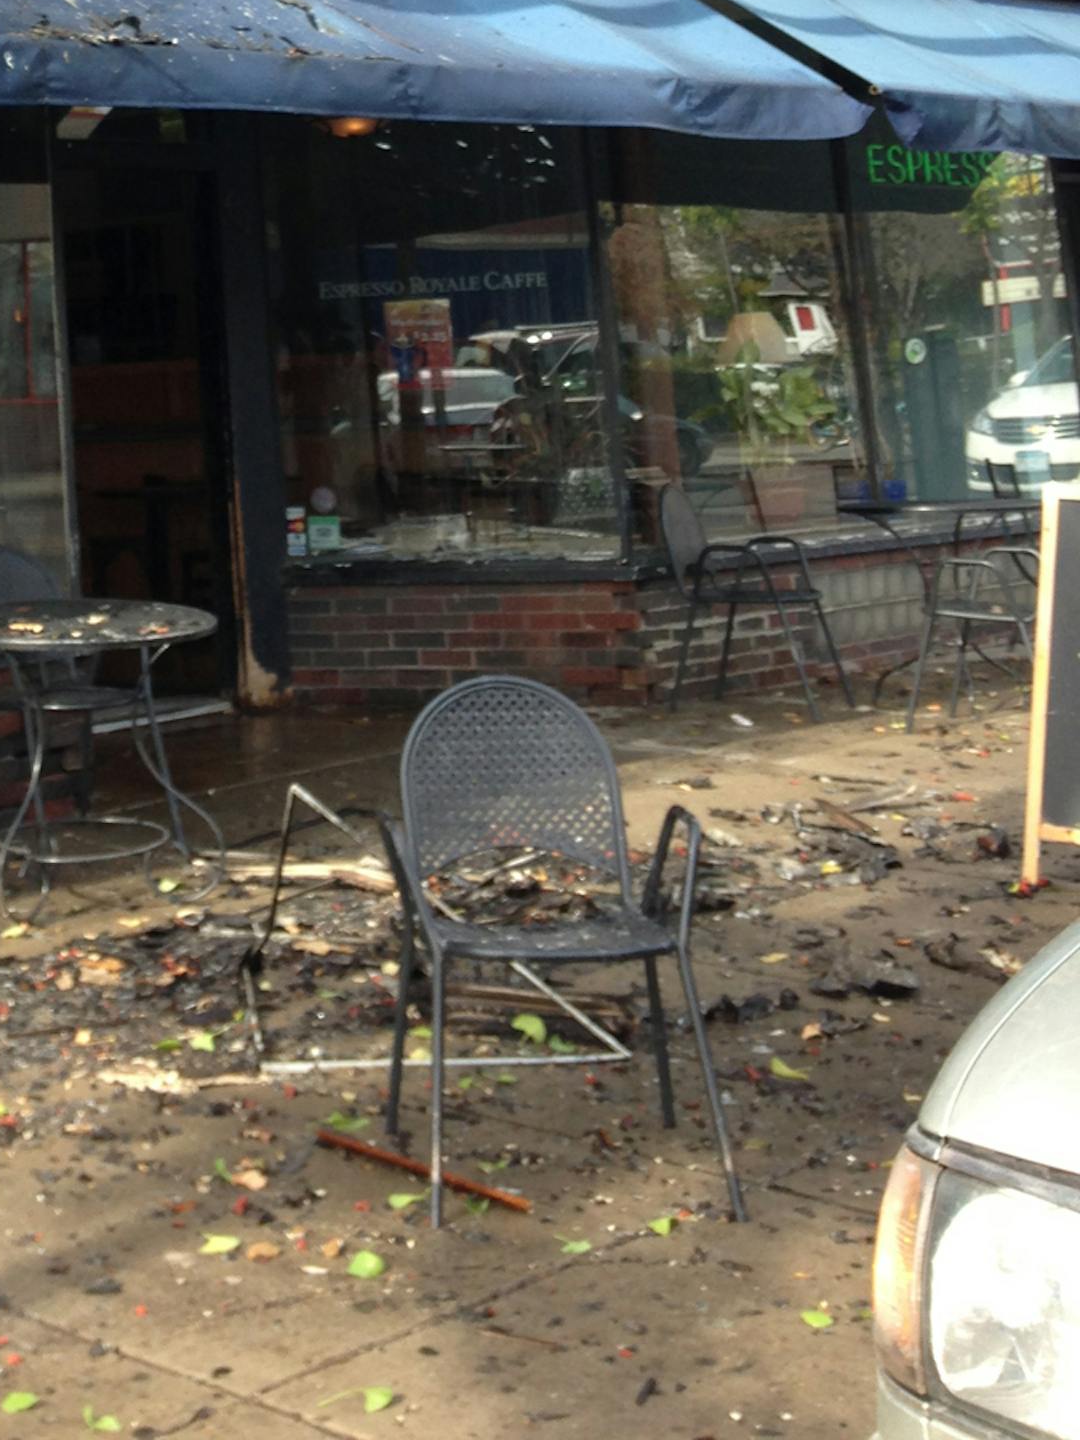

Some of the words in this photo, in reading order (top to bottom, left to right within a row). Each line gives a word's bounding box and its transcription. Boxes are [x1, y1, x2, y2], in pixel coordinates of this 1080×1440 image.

[319, 281, 405, 299] ESPRESSO
[408, 276, 482, 294] ROYALE
[483, 271, 549, 290] CAFFE
